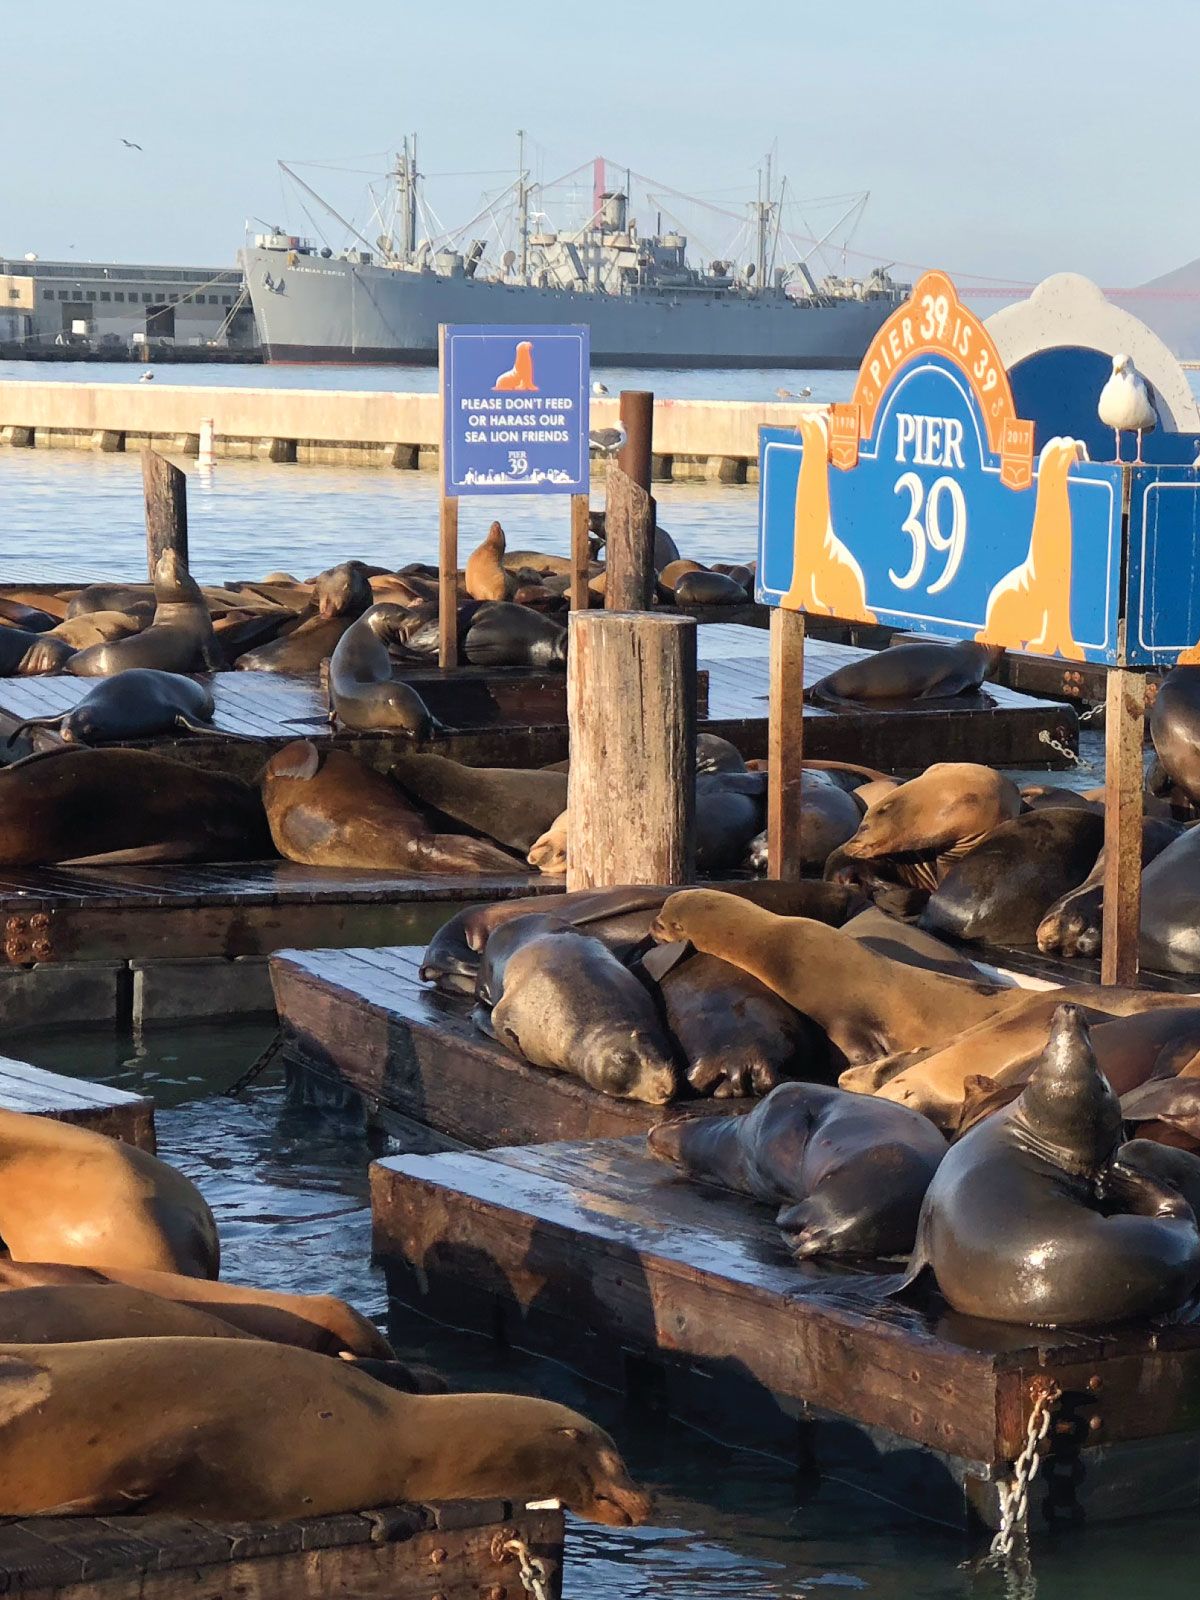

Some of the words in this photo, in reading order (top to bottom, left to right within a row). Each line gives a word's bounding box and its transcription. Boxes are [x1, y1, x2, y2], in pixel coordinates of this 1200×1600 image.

[869, 318, 915, 389] PIER
[920, 294, 949, 340] 39
[952, 318, 972, 356] IS
[973, 349, 998, 392] 39
[461, 398, 502, 410] PLEASE
[505, 398, 542, 410] DON'T
[545, 398, 573, 409] FEED
[468, 415, 487, 426] OR
[490, 415, 536, 426] HARASS
[539, 415, 565, 426] OUR
[465, 431, 487, 442] SEA
[491, 431, 519, 442] LION
[522, 431, 569, 442] FRIENDS
[895, 413, 965, 469] PIER
[1007, 430, 1029, 443] 2017
[508, 450, 527, 458] PIER
[507, 458, 528, 475] 39
[888, 472, 967, 595] 39
